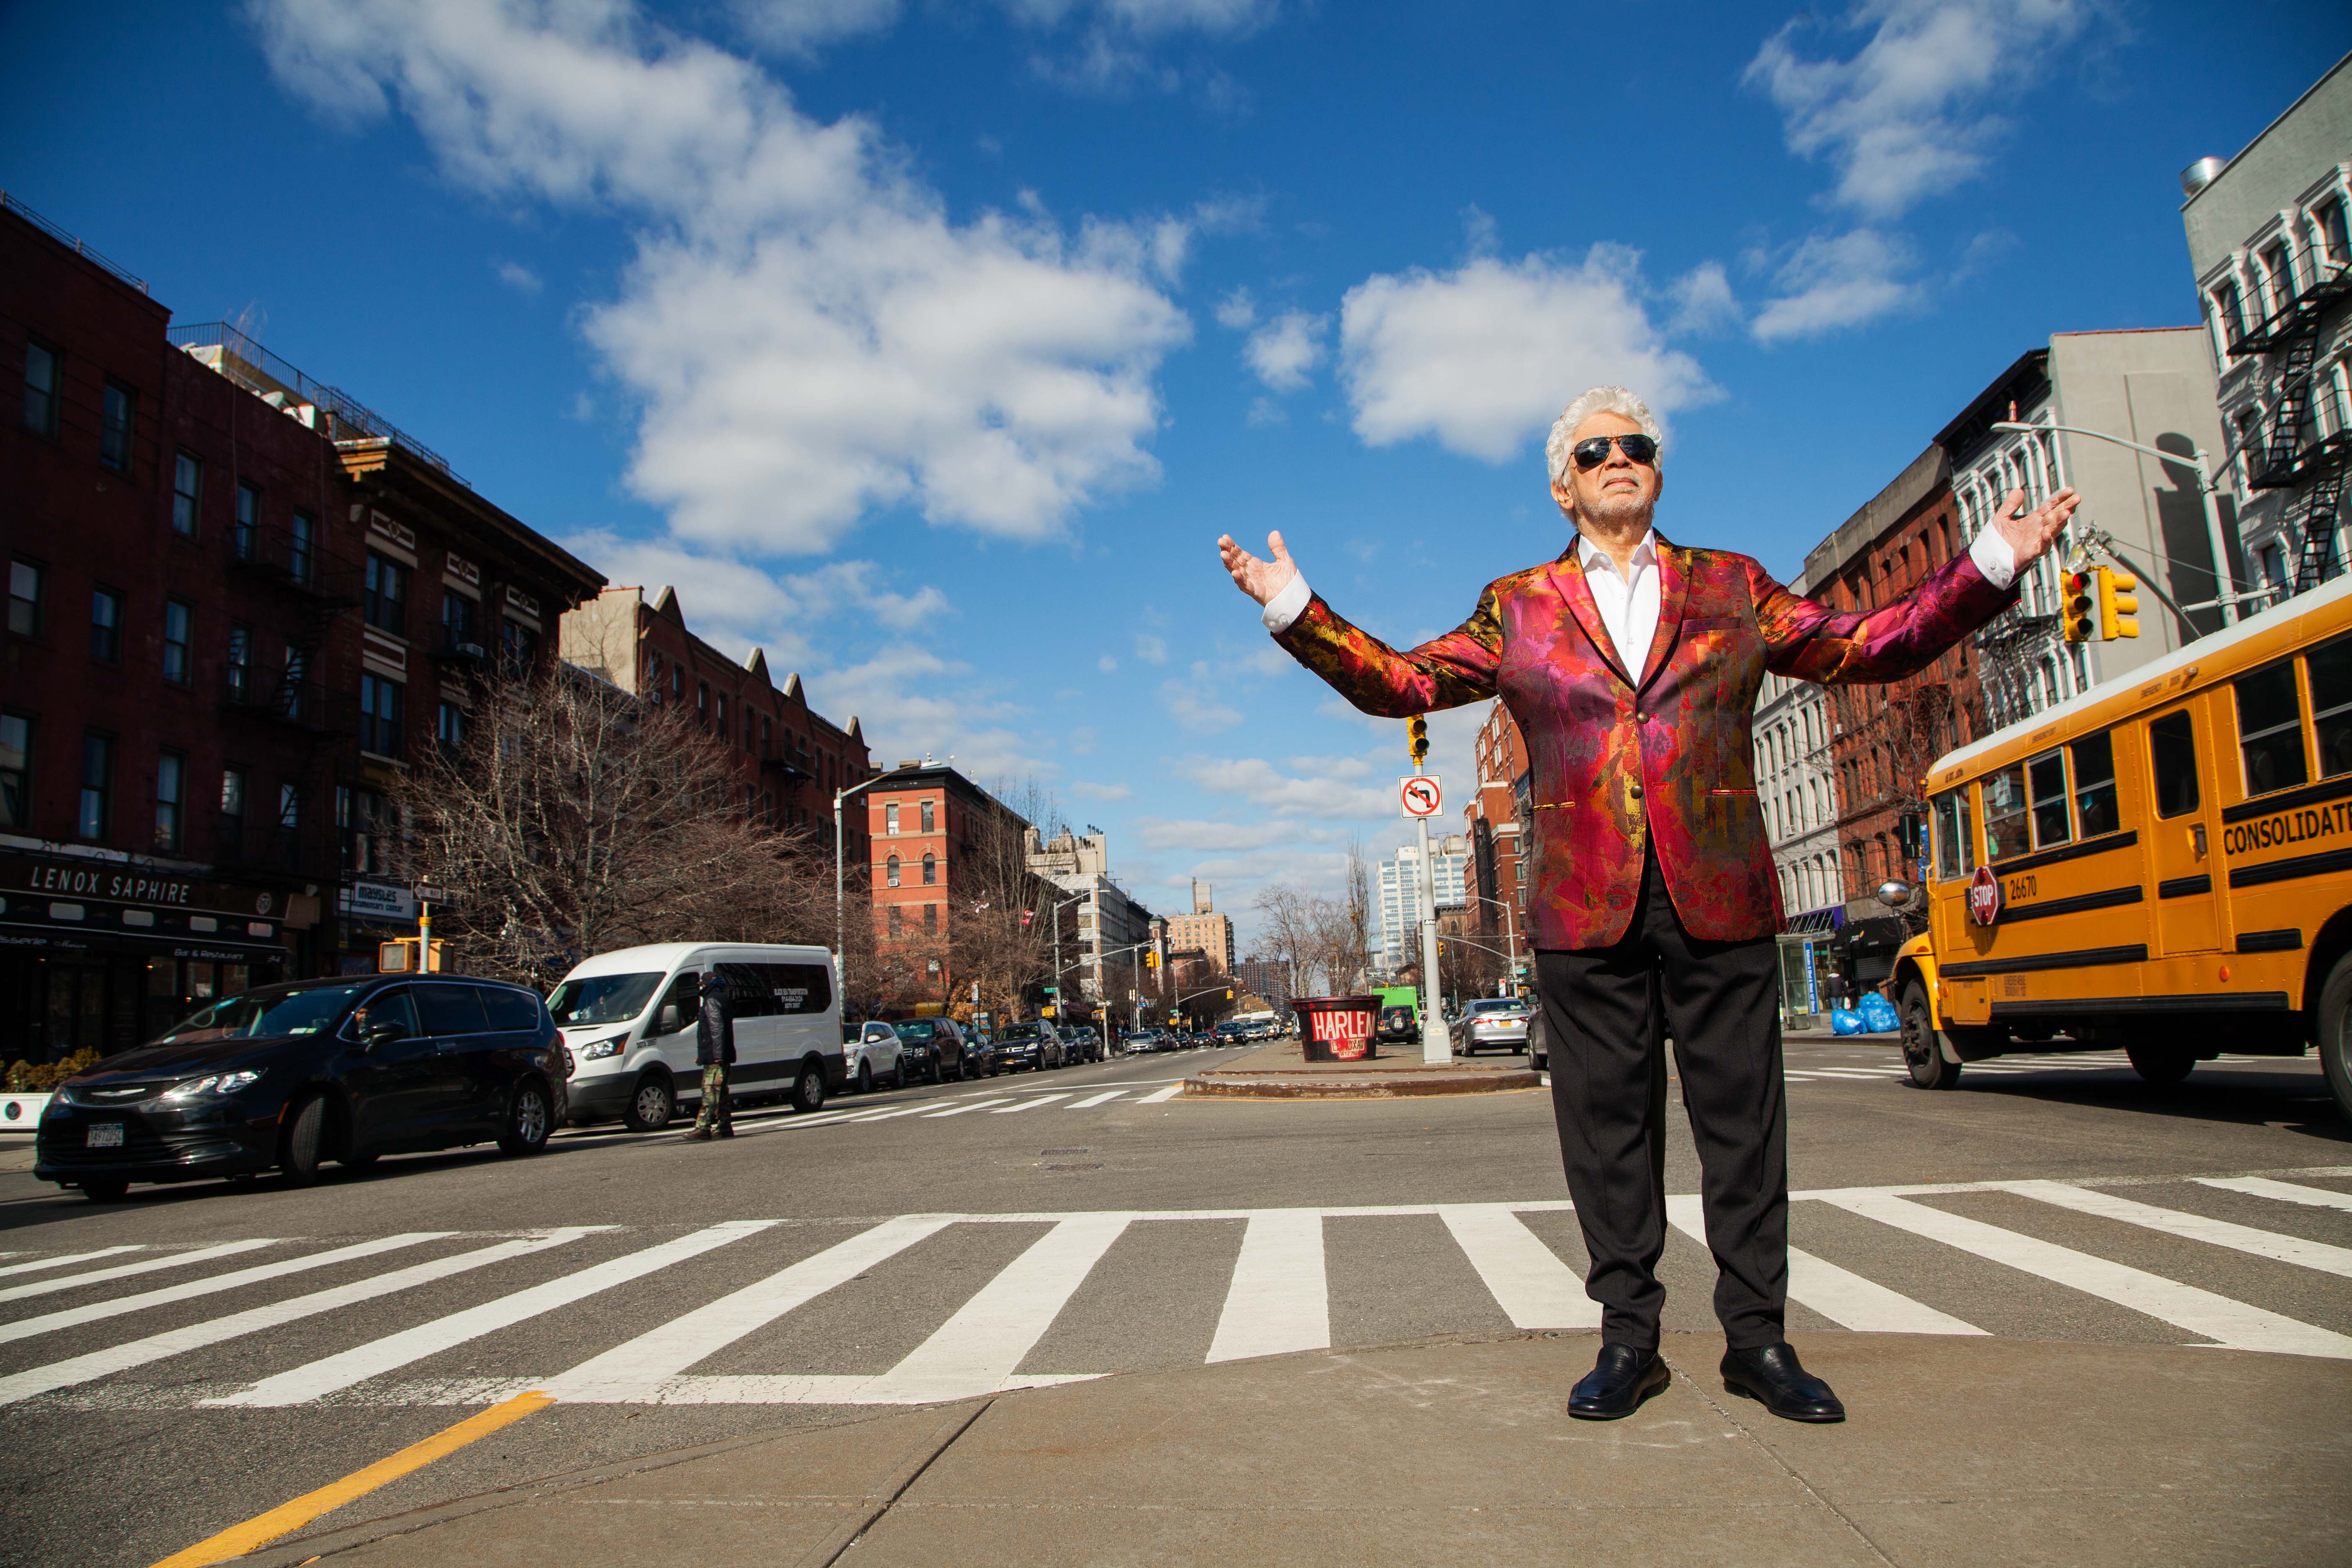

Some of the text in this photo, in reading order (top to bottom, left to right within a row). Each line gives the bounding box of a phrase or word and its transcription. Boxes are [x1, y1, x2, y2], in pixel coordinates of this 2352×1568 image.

[30, 865, 191, 904] LENOX SAPHIRE
[418, 887, 439, 897] ONE WAY
[1973, 885, 1994, 907] STOP
[2010, 875, 2037, 900] 26670
[174, 948, 189, 957] Bar
[191, 949, 199, 958] &
[201, 950, 246, 960] Restaurant
[1313, 1011, 1376, 1039] HARLEM
